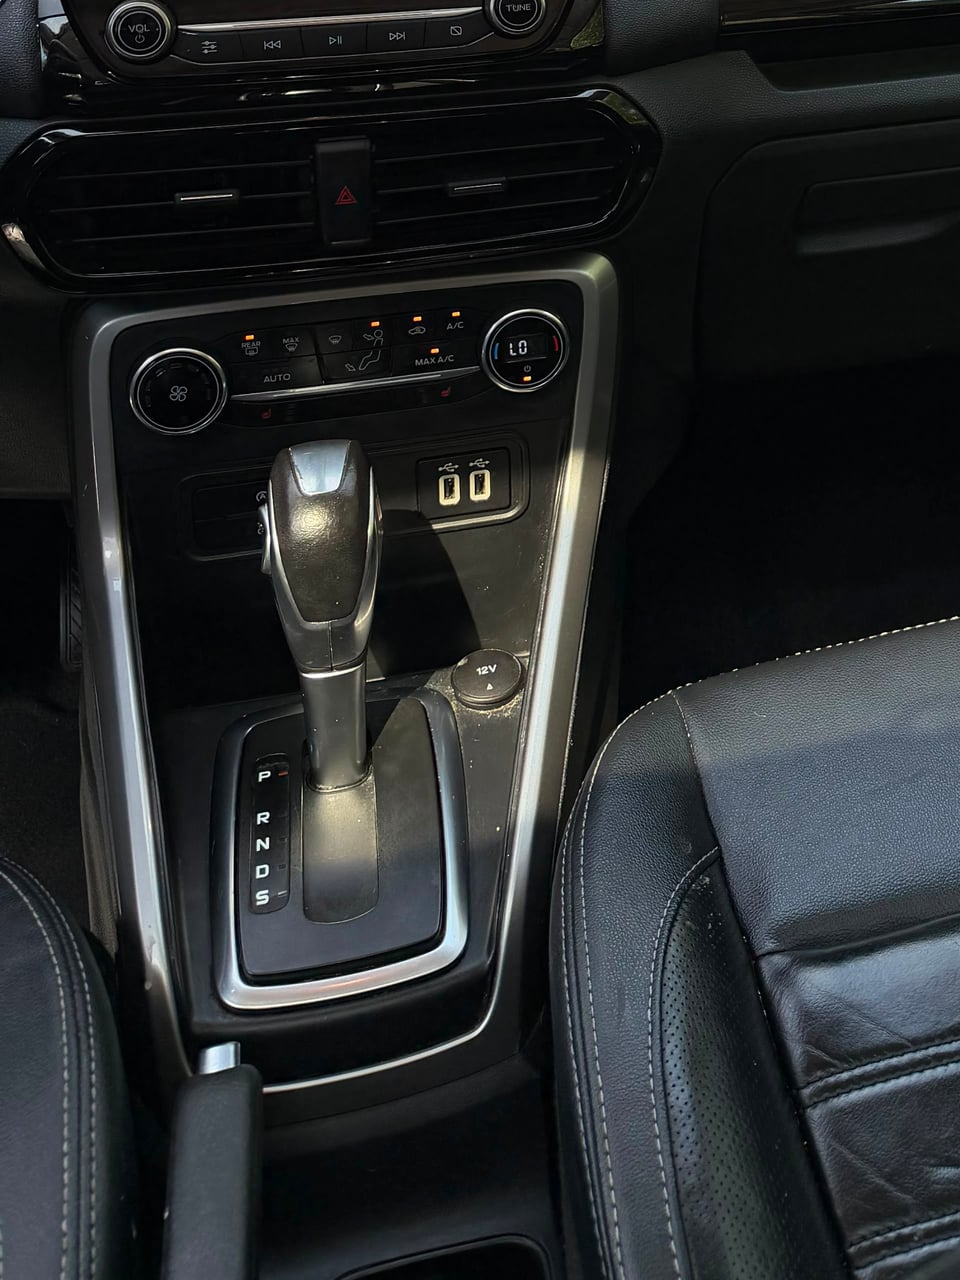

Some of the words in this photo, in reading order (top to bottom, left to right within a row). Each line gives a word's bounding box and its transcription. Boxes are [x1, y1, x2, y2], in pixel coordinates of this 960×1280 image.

[505, 3, 532, 13] TUNE
[127, 23, 151, 34] VOL
[446, 321, 465, 330] A/C
[241, 340, 261, 349] REAR
[282, 336, 300, 345] MAX
[509, 339, 528, 356] LO
[414, 357, 436, 367] MAX
[437, 354, 455, 364] A/C
[263, 373, 291, 383] AUTO
[476, 663, 497, 676] 12V
[258, 770, 272, 783] P
[256, 811, 271, 825] R
[256, 836, 270, 852] N
[255, 863, 270, 879] D
[255, 889, 270, 906] S
